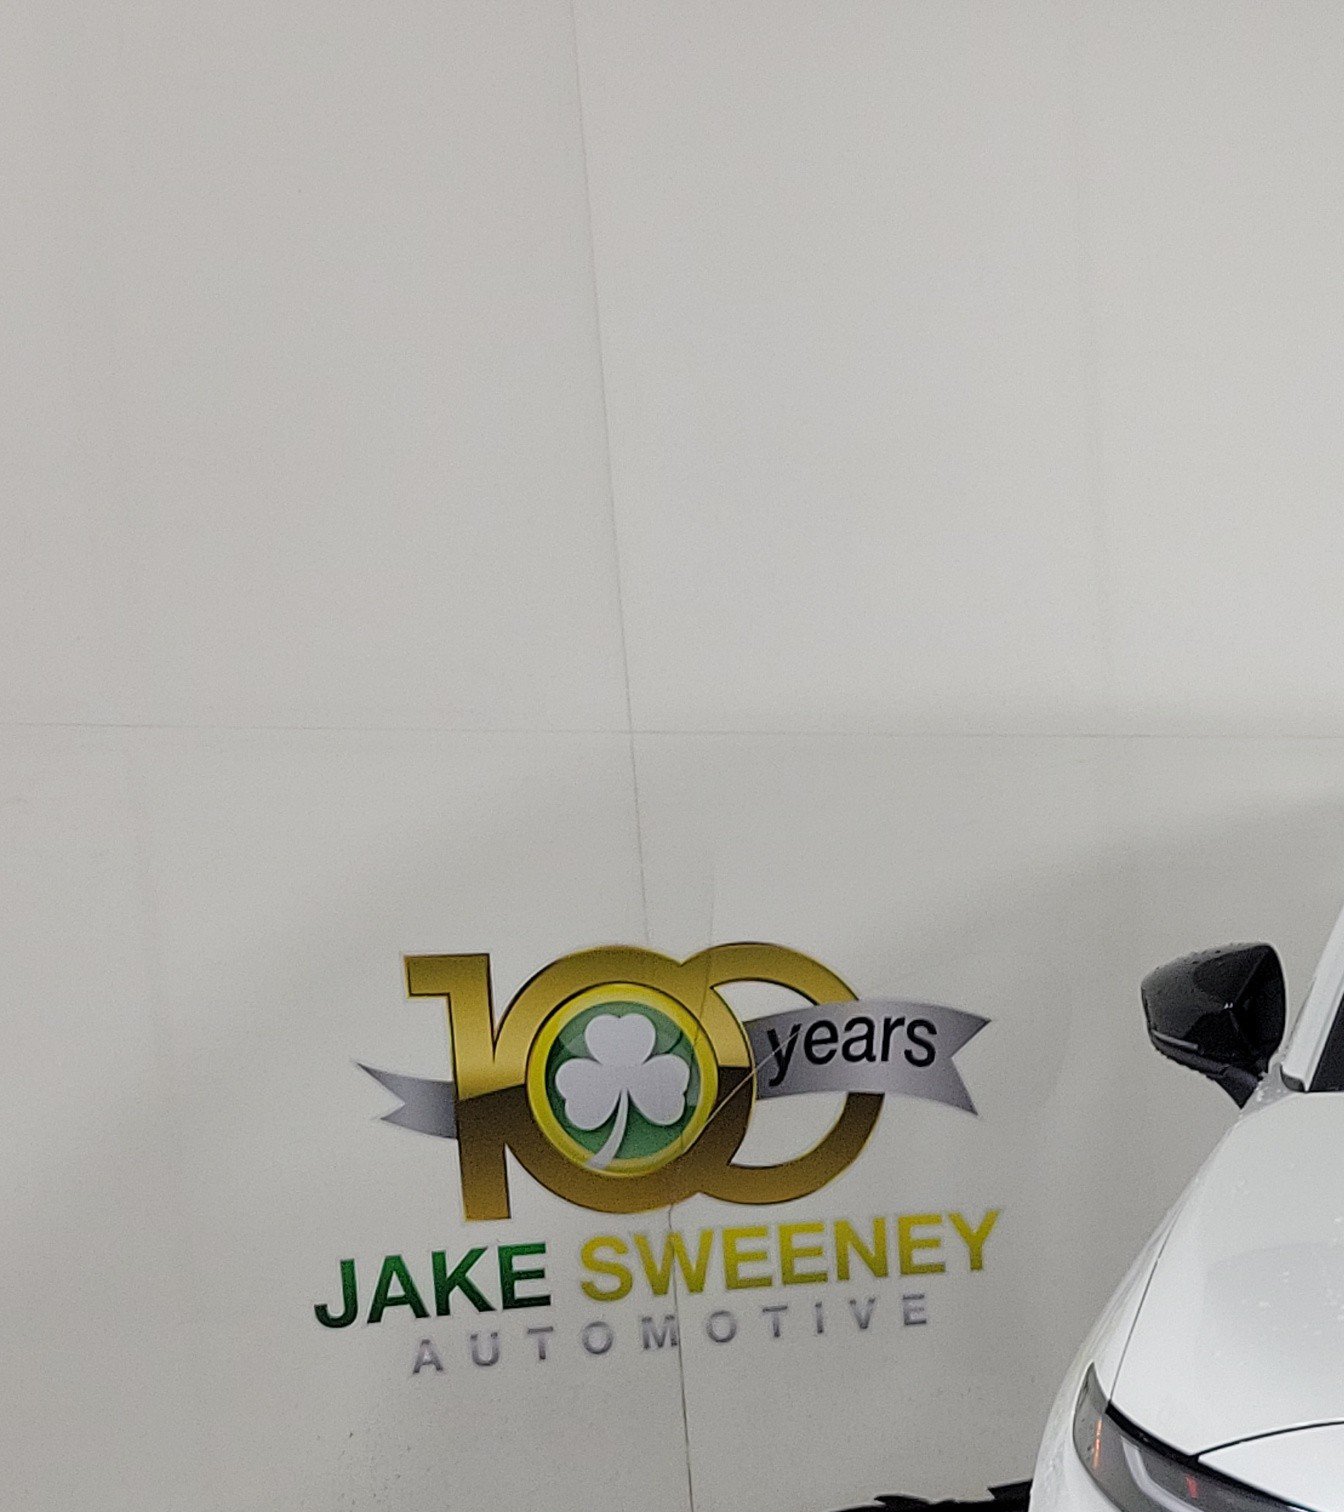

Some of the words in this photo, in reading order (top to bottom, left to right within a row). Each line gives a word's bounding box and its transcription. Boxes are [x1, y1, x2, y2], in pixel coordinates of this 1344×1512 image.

[403, 941, 886, 1222] 100
[767, 1015, 938, 1086] years
[314, 1241, 552, 1329] JAKE
[580, 1208, 1000, 1303] SWEENEY
[412, 1294, 927, 1375] AUTOMOTIVE
